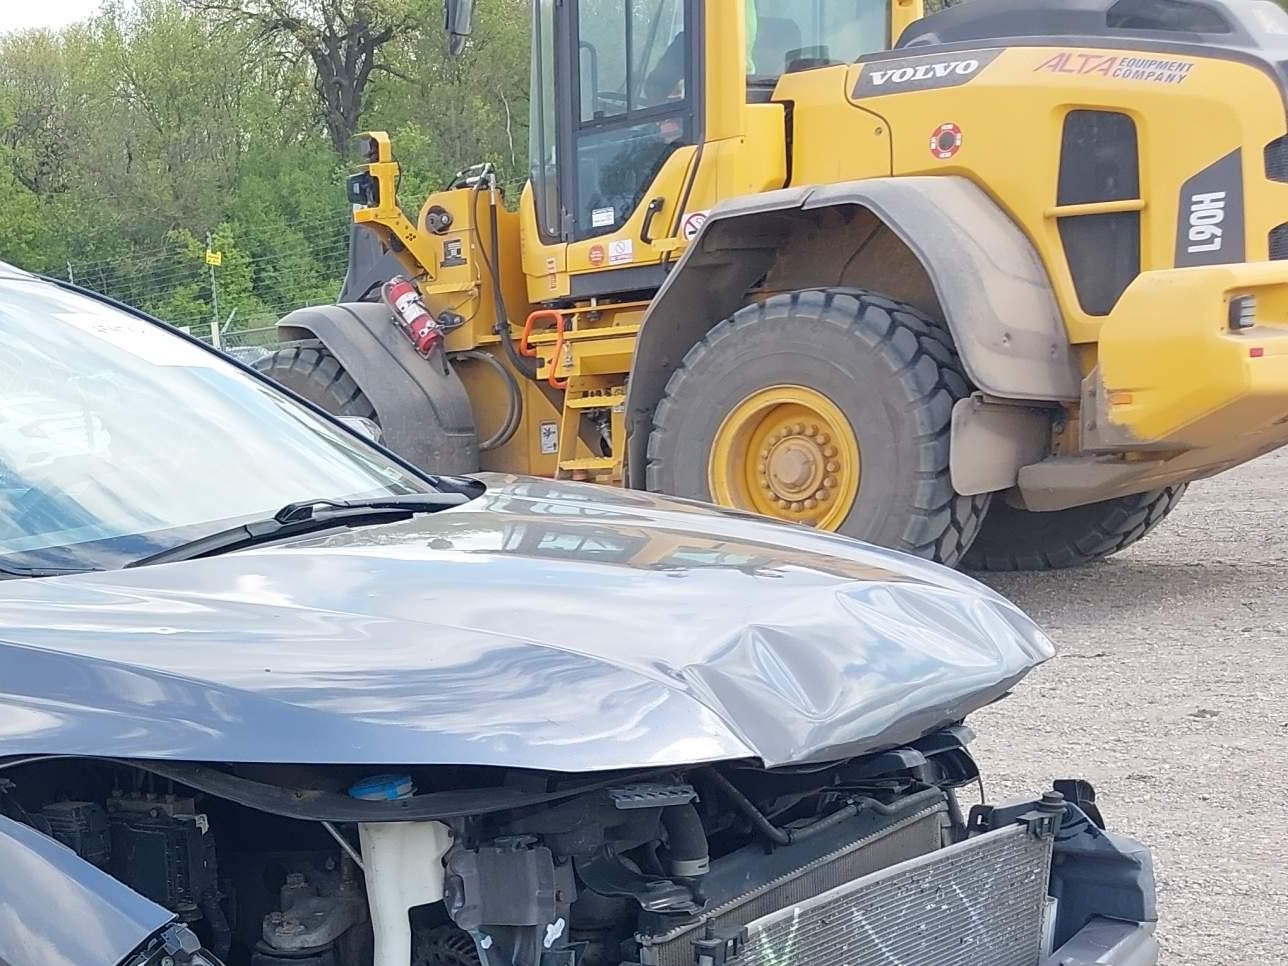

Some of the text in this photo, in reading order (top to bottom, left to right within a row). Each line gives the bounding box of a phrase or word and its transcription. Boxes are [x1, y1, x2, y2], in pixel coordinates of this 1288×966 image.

[868, 59, 979, 86] VOLVO
[1032, 52, 1195, 77] ALTA EQUIPMENT
[1112, 67, 1187, 84] COMPANY
[1187, 191, 1226, 253] L90H
